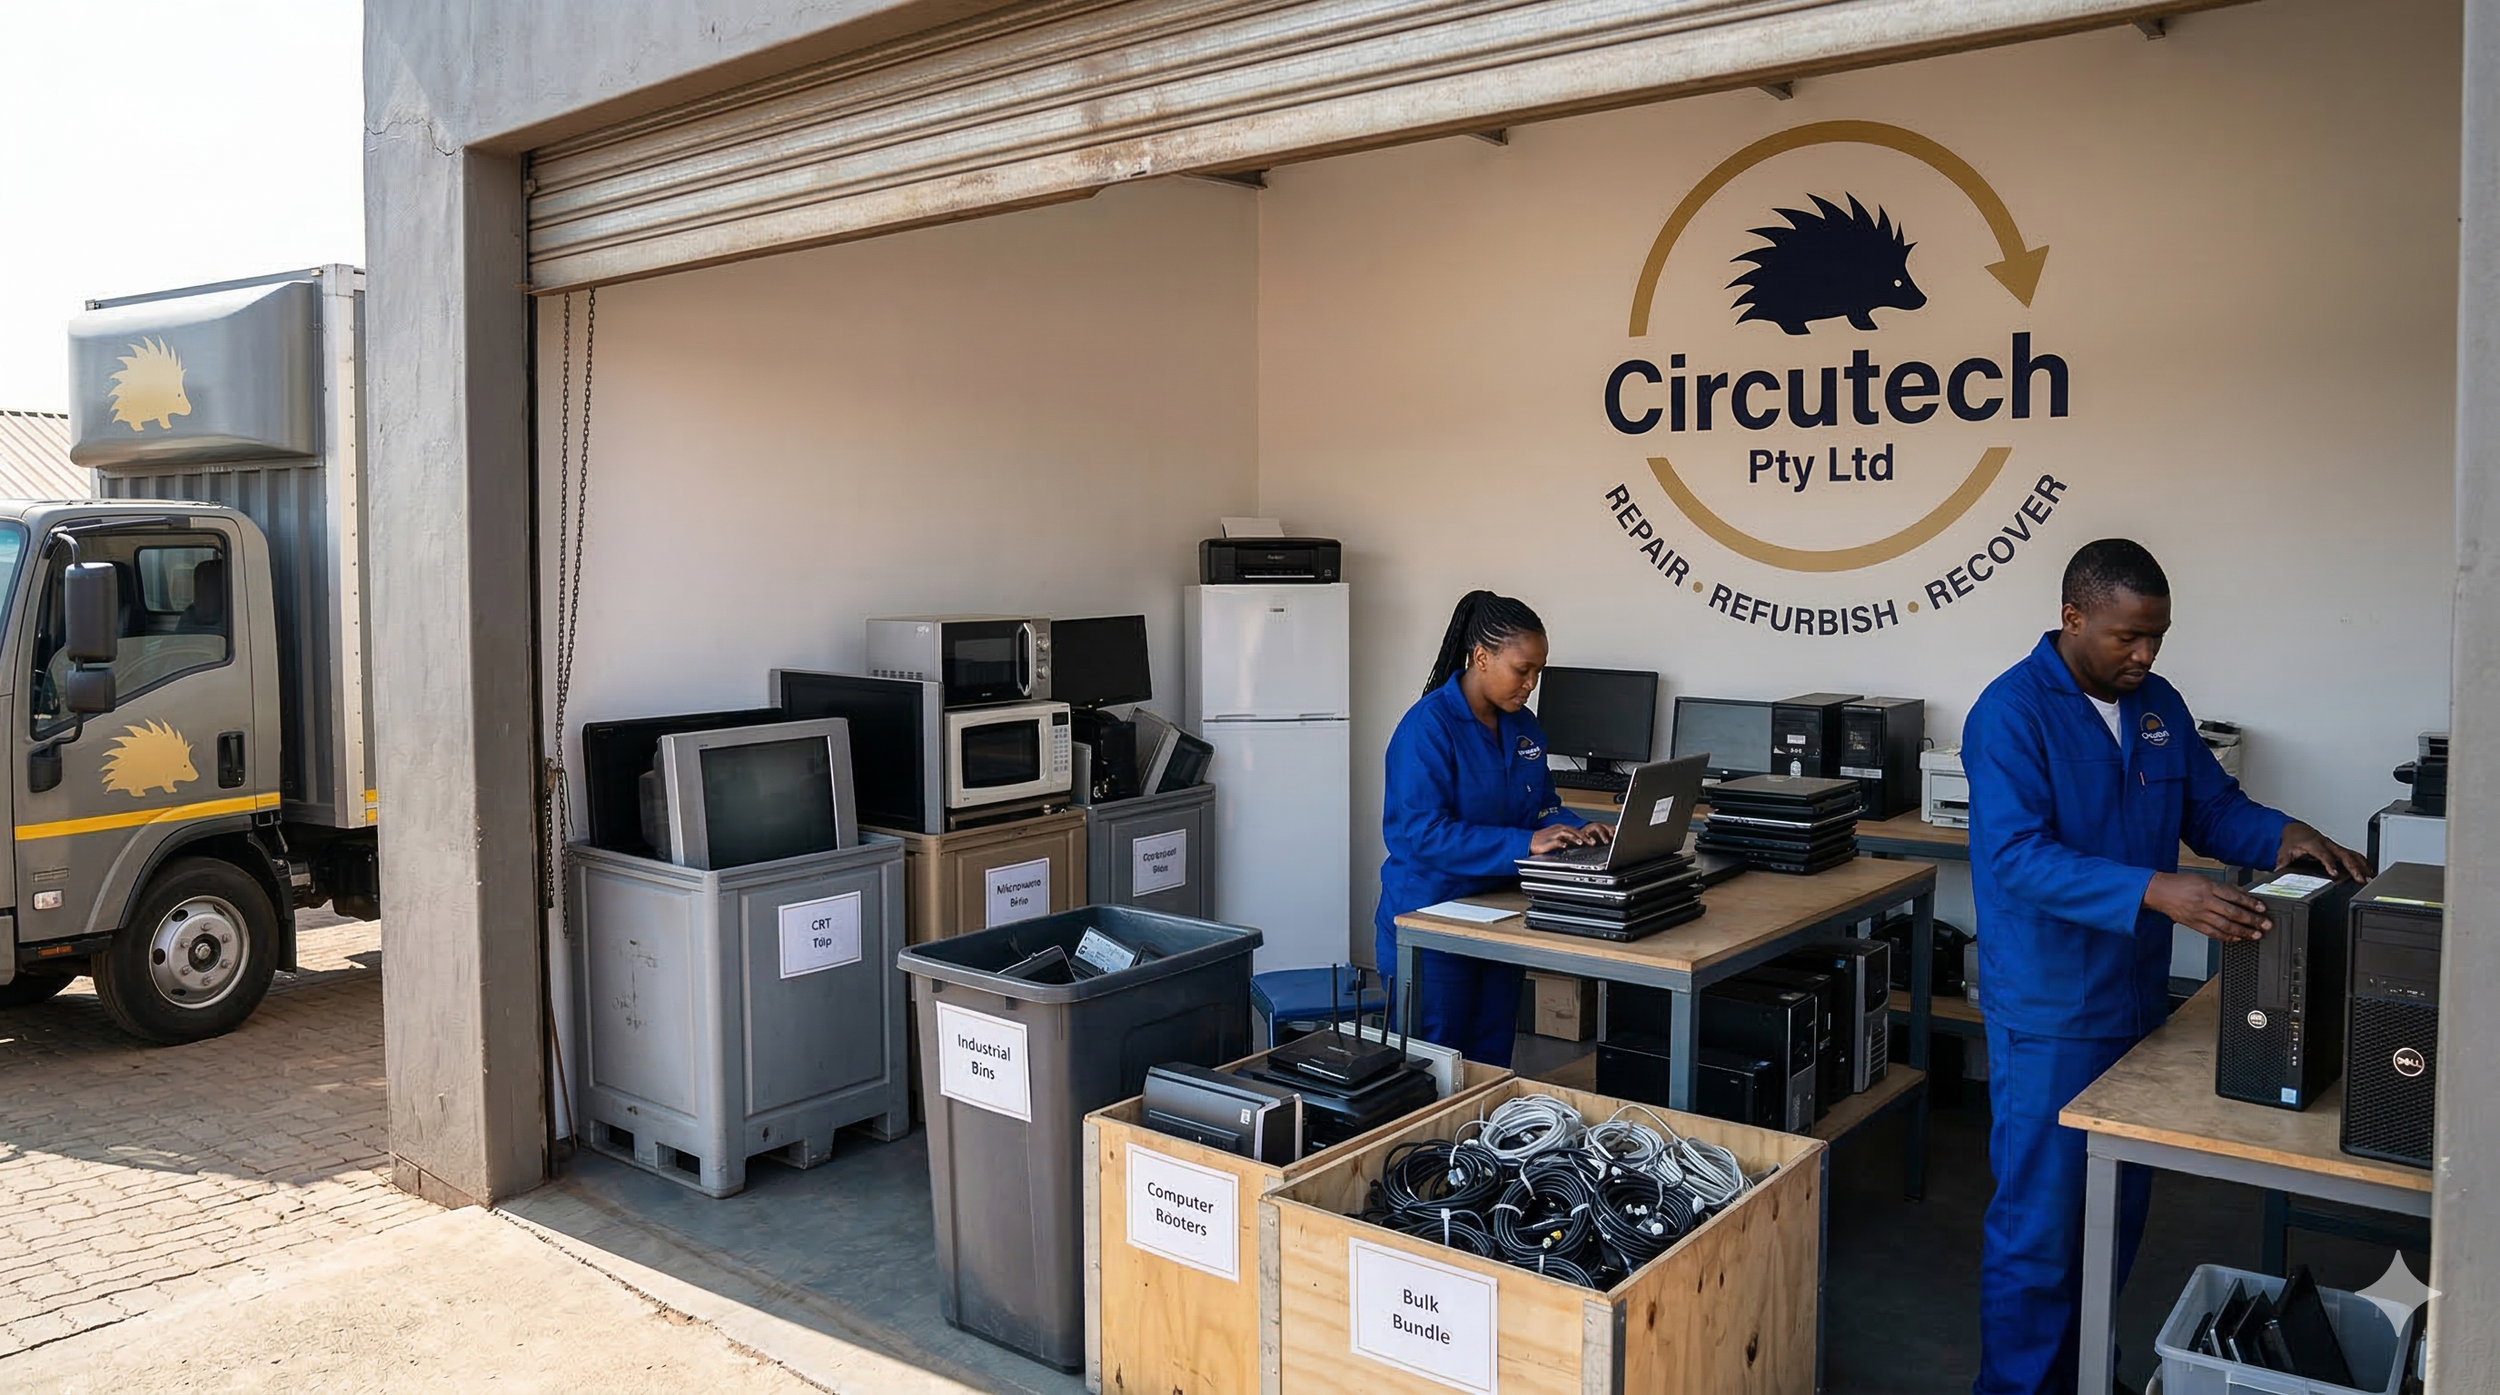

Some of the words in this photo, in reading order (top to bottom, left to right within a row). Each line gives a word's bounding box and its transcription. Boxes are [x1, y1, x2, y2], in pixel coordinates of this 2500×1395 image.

[1604, 331, 2069, 435] Circutech
[1749, 449, 1815, 492] Pty
[1828, 443, 1894, 482] Ltd
[1605, 483, 1691, 586] REPAIR
[1708, 583, 1899, 636] REFURBISH
[1924, 473, 2068, 610] RECOVER
[811, 917, 832, 930] CRT
[958, 1034, 1011, 1061] Industrial
[971, 1061, 995, 1080] Bins
[1147, 1181, 1214, 1214] Computer
[1156, 1207, 1207, 1236] Rooters
[1403, 1288, 1439, 1314] Bulk
[1393, 1313, 1450, 1345] Bundle
